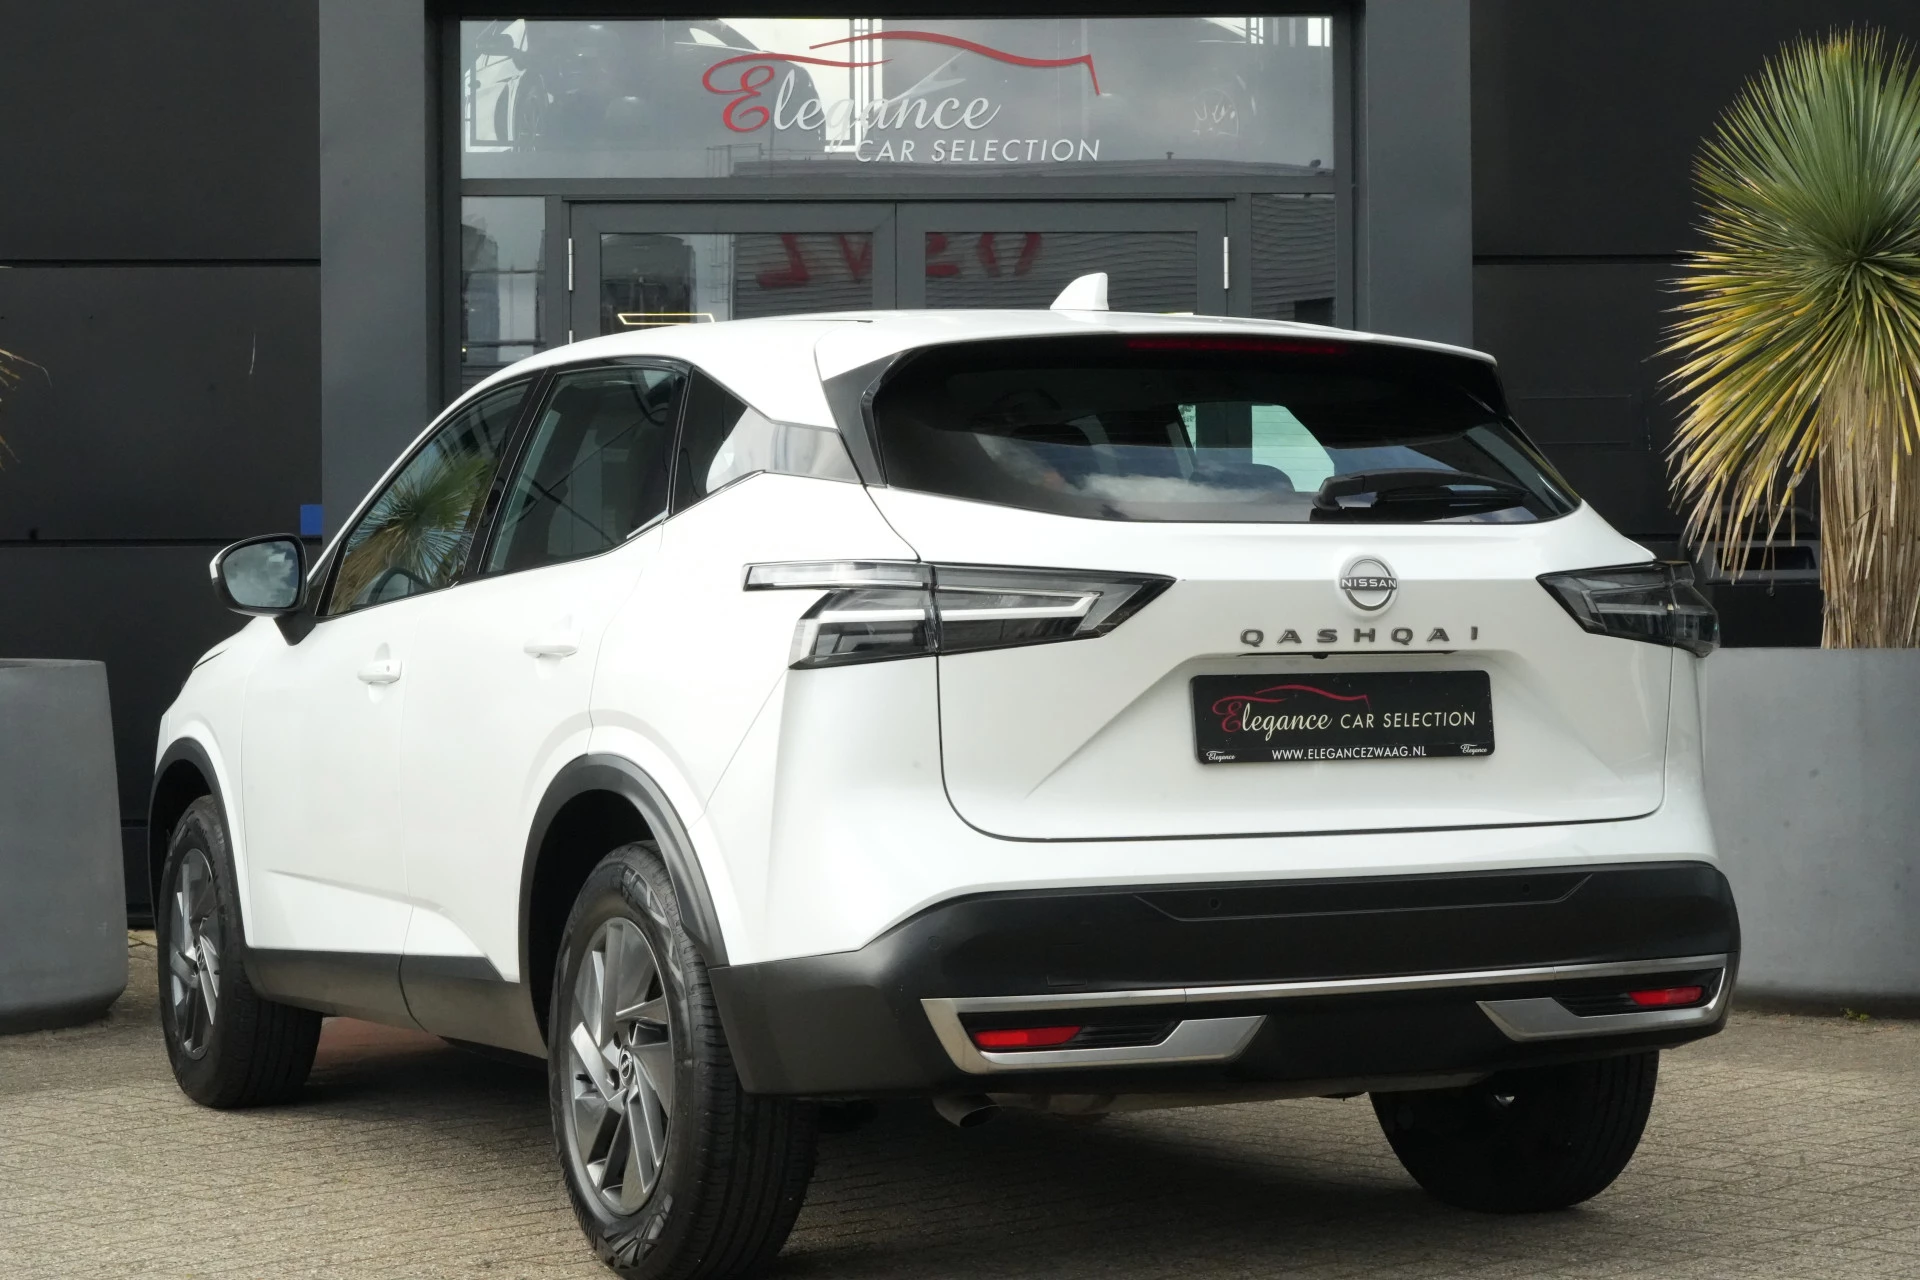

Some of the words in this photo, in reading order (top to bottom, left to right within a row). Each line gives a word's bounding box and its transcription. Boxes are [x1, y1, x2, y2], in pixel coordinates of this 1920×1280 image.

[702, 53, 1001, 154] Elegance
[855, 139, 915, 163] CAR
[931, 139, 1101, 163] SELECTION
[1341, 578, 1397, 588] NISSAN
[1239, 626, 1479, 648] QASHQAI
[1212, 695, 1332, 741] Elegance
[1340, 713, 1375, 729] CAR
[1383, 711, 1476, 728] SELECTION
[1206, 750, 1236, 762] Elegance
[1271, 745, 1427, 760] WWW.ELEGANCEZWAAG.NL
